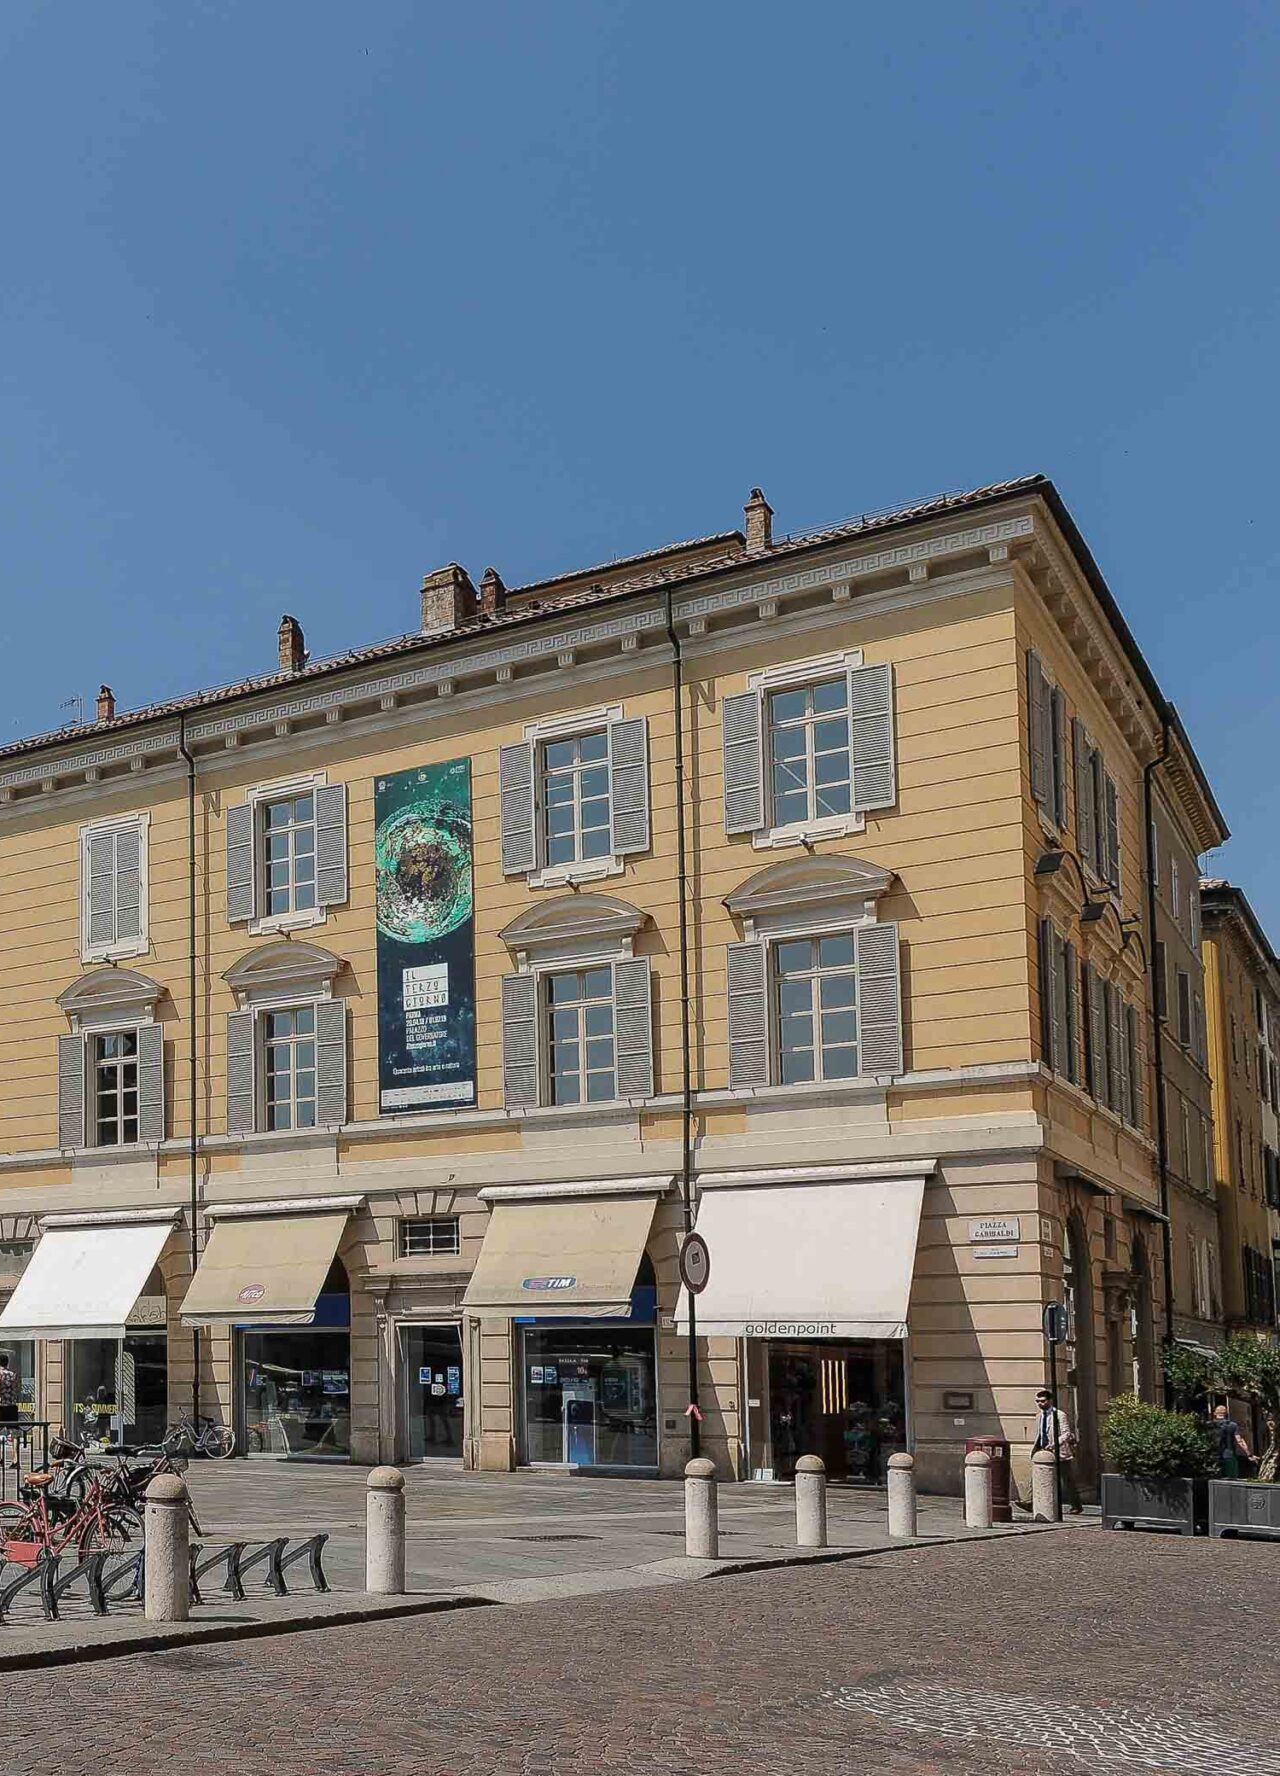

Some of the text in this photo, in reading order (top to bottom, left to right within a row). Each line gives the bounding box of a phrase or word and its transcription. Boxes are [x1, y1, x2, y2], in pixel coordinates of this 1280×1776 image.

[406, 971, 416, 980] IL
[405, 981, 439, 994] TERZO
[406, 993, 446, 1008] GIORNO
[548, 1279, 571, 1288] TIM
[745, 1321, 836, 1336] goldenpoint
